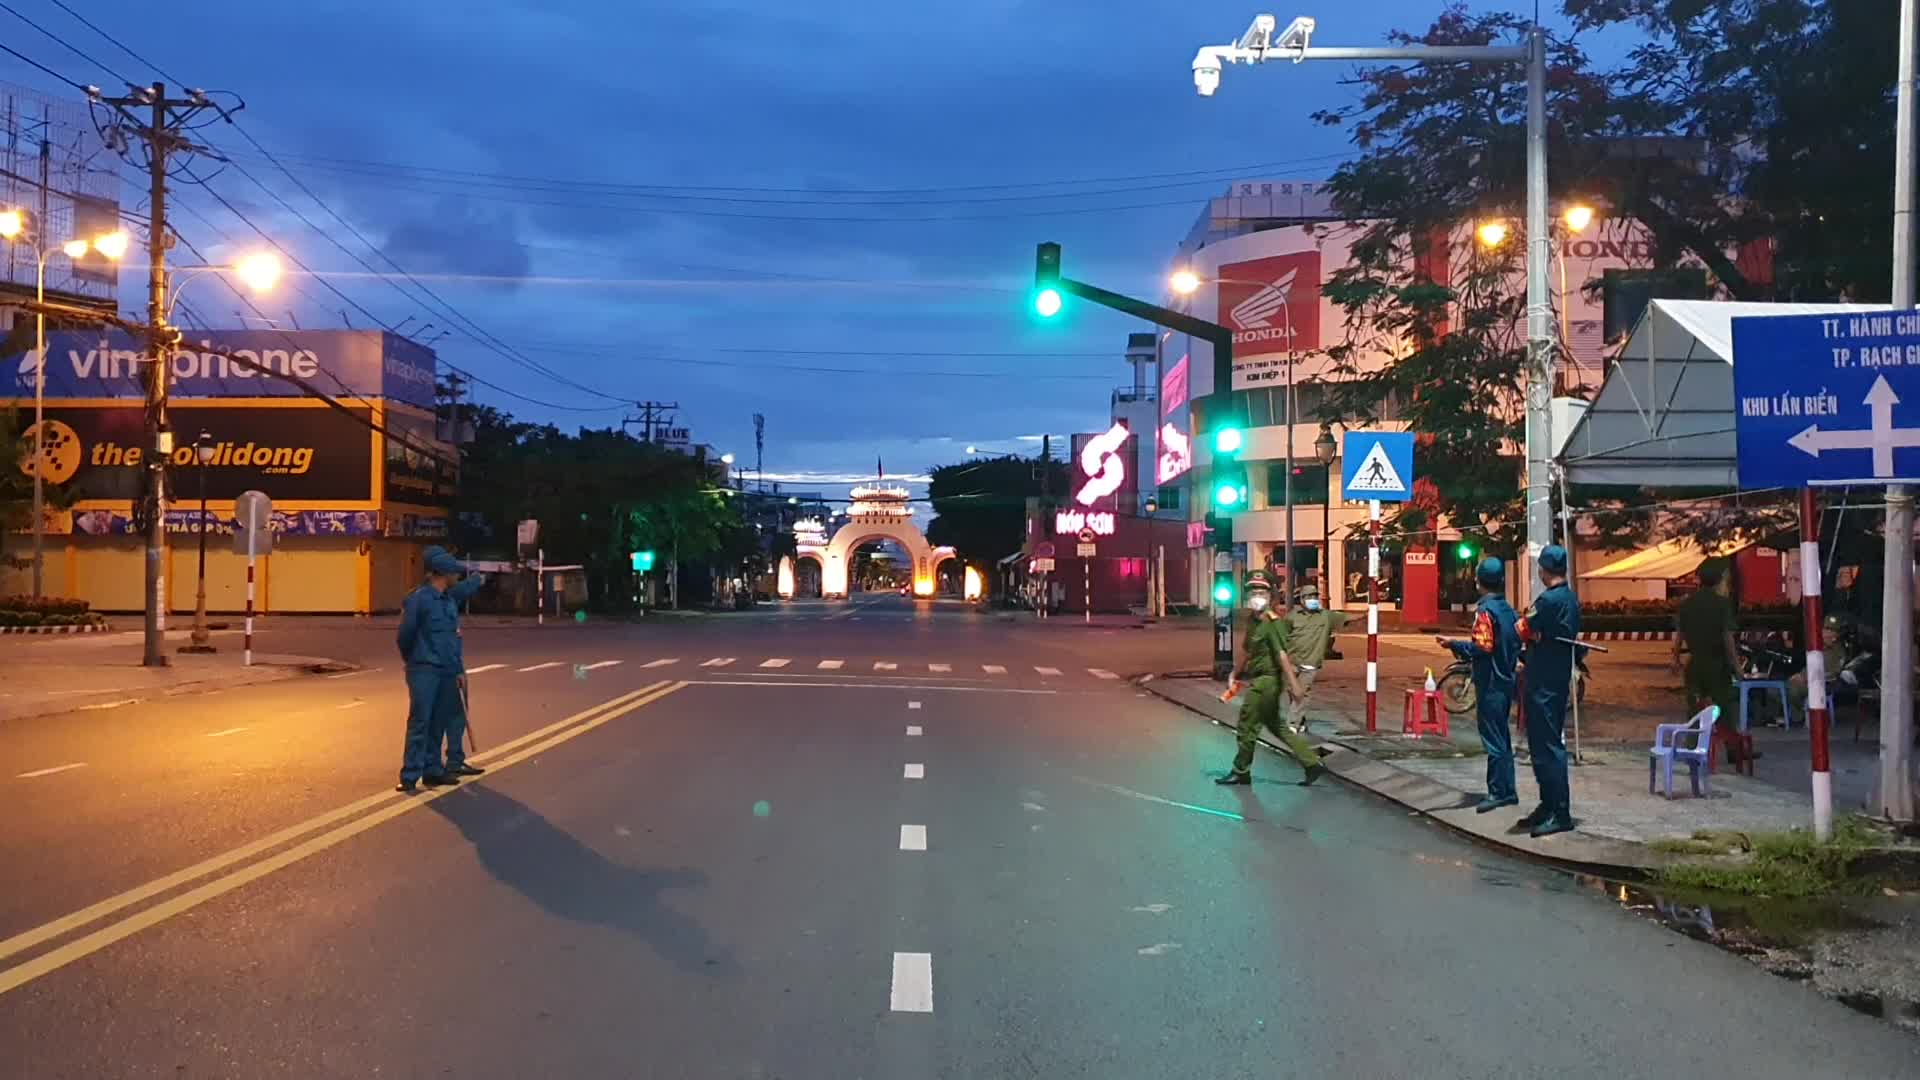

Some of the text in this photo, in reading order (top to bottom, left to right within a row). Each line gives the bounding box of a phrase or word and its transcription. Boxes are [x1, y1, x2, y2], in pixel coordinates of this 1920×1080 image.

[1232, 327, 1297, 343] HONDA
[1822, 319, 1845, 338] TT.
[1850, 313, 1892, 337] HÀNH
[1832, 348, 1856, 368] TP.
[1860, 345, 1901, 370] RẠCH
[1743, 386, 1838, 416] KHU LẤN BIỂN
